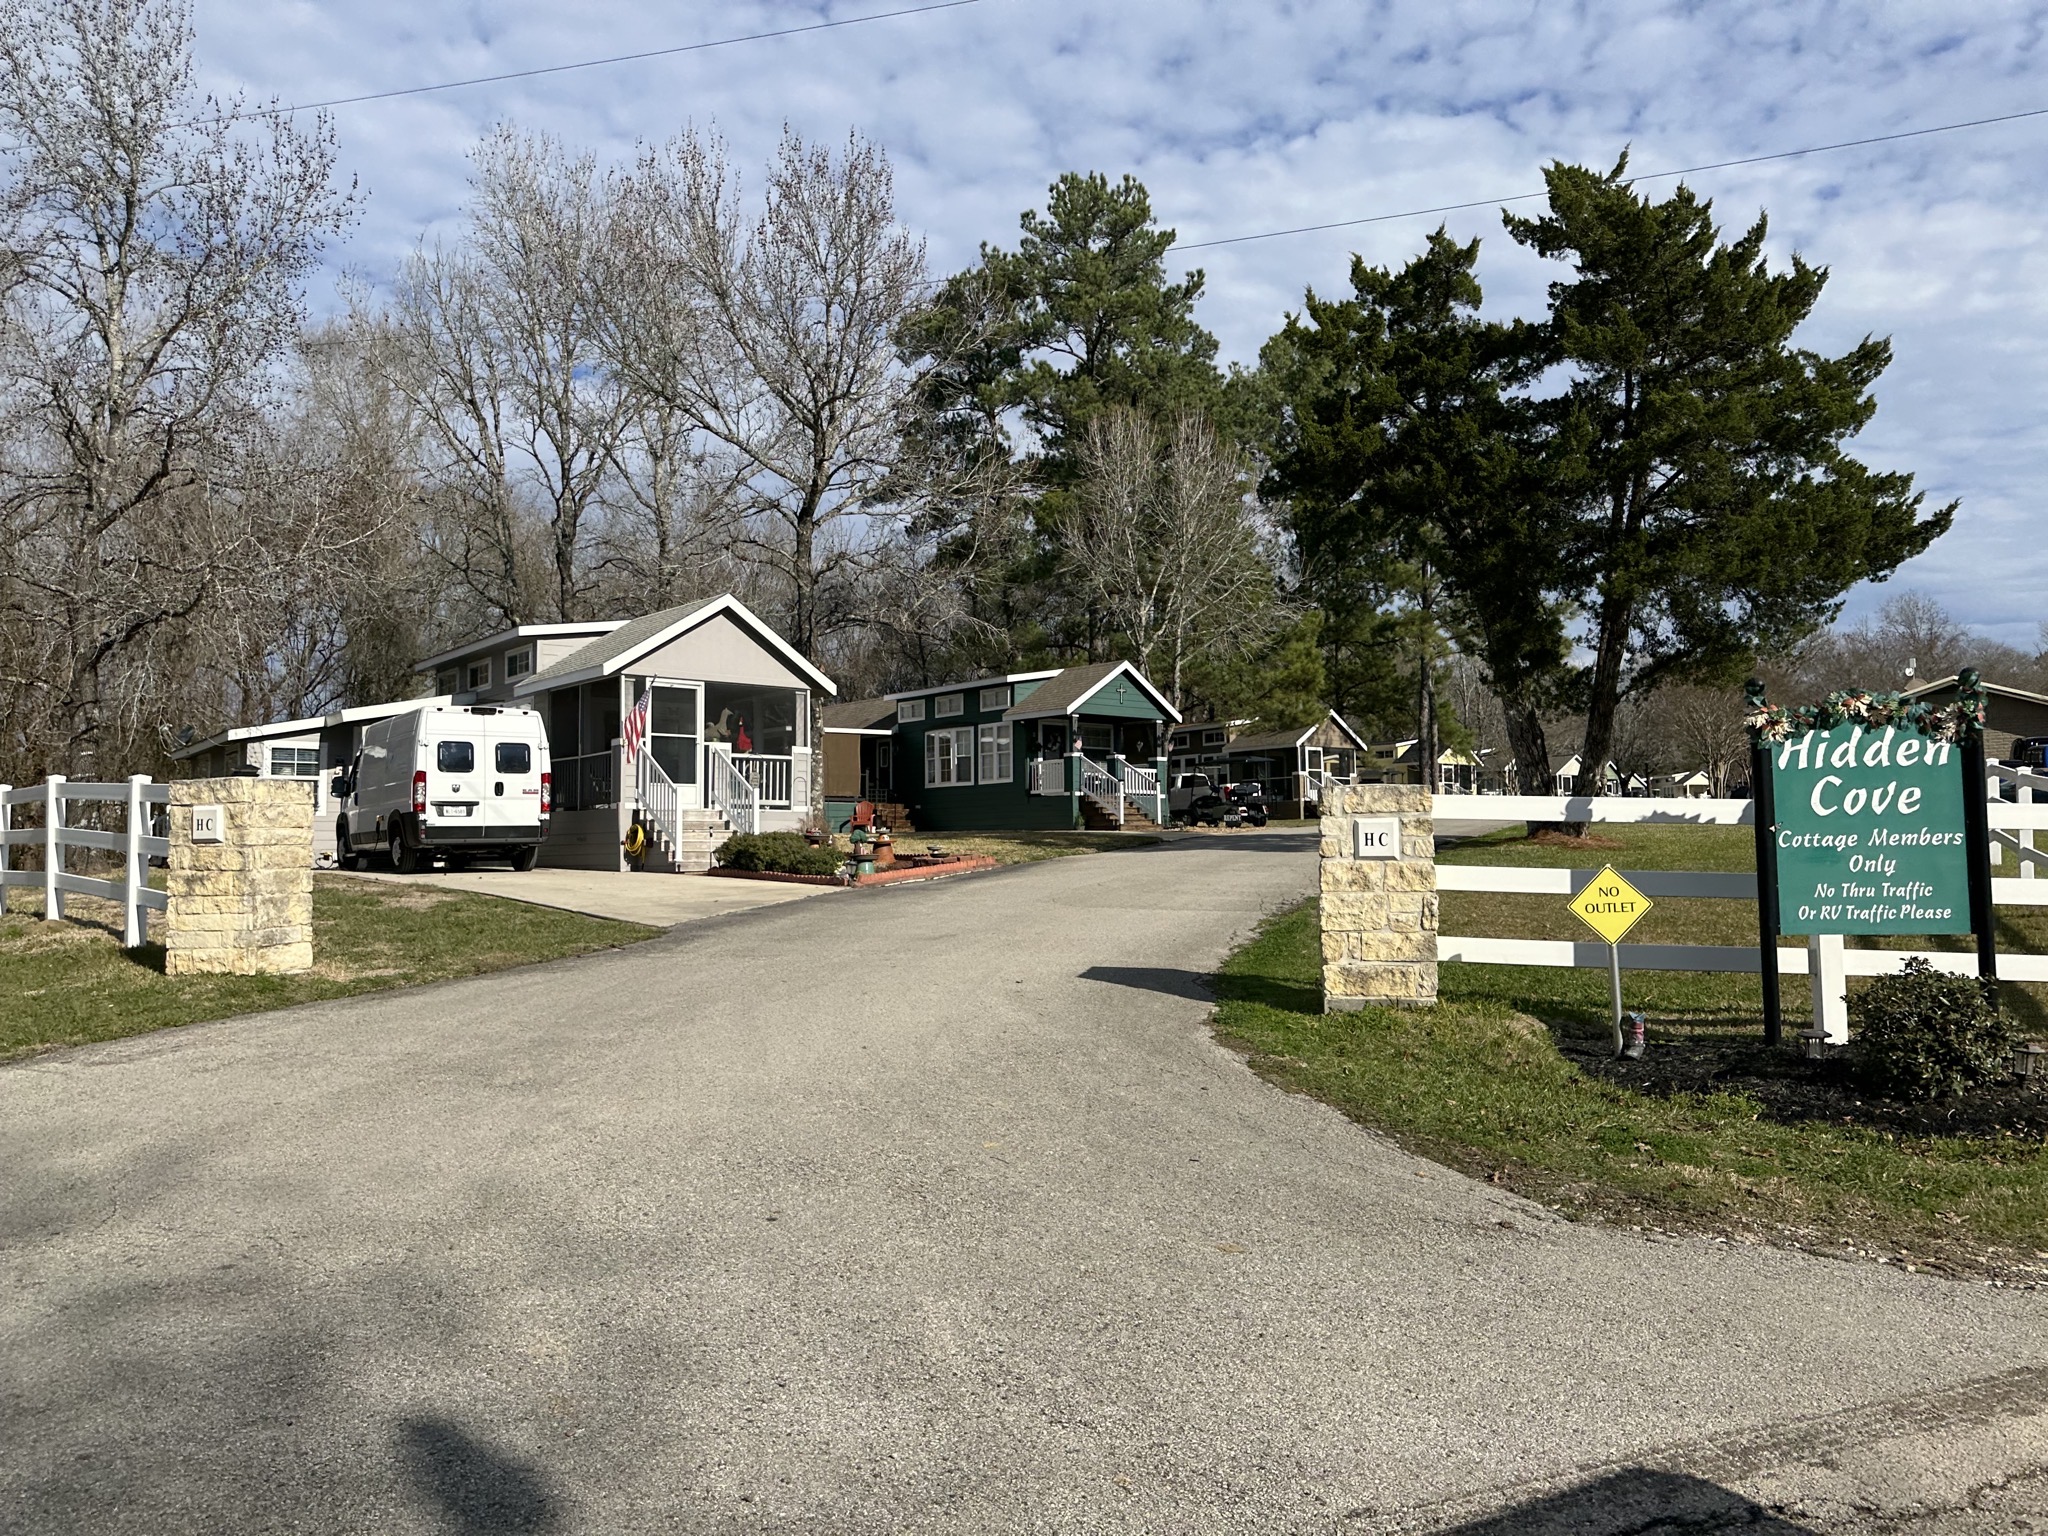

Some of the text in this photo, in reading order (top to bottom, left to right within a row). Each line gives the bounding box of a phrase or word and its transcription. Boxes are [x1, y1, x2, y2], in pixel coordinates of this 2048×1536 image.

[1777, 725, 1951, 771] Hidden
[1810, 775, 1922, 817] Cove
[1778, 827, 1964, 851] Cottage Members
[1849, 853, 1897, 877] Only
[1598, 886, 1620, 898] NO
[1814, 881, 1933, 901] No Thru Traffic
[1584, 901, 1637, 914] OUTLET
[1798, 903, 1952, 924] Or RV Traffic Please
